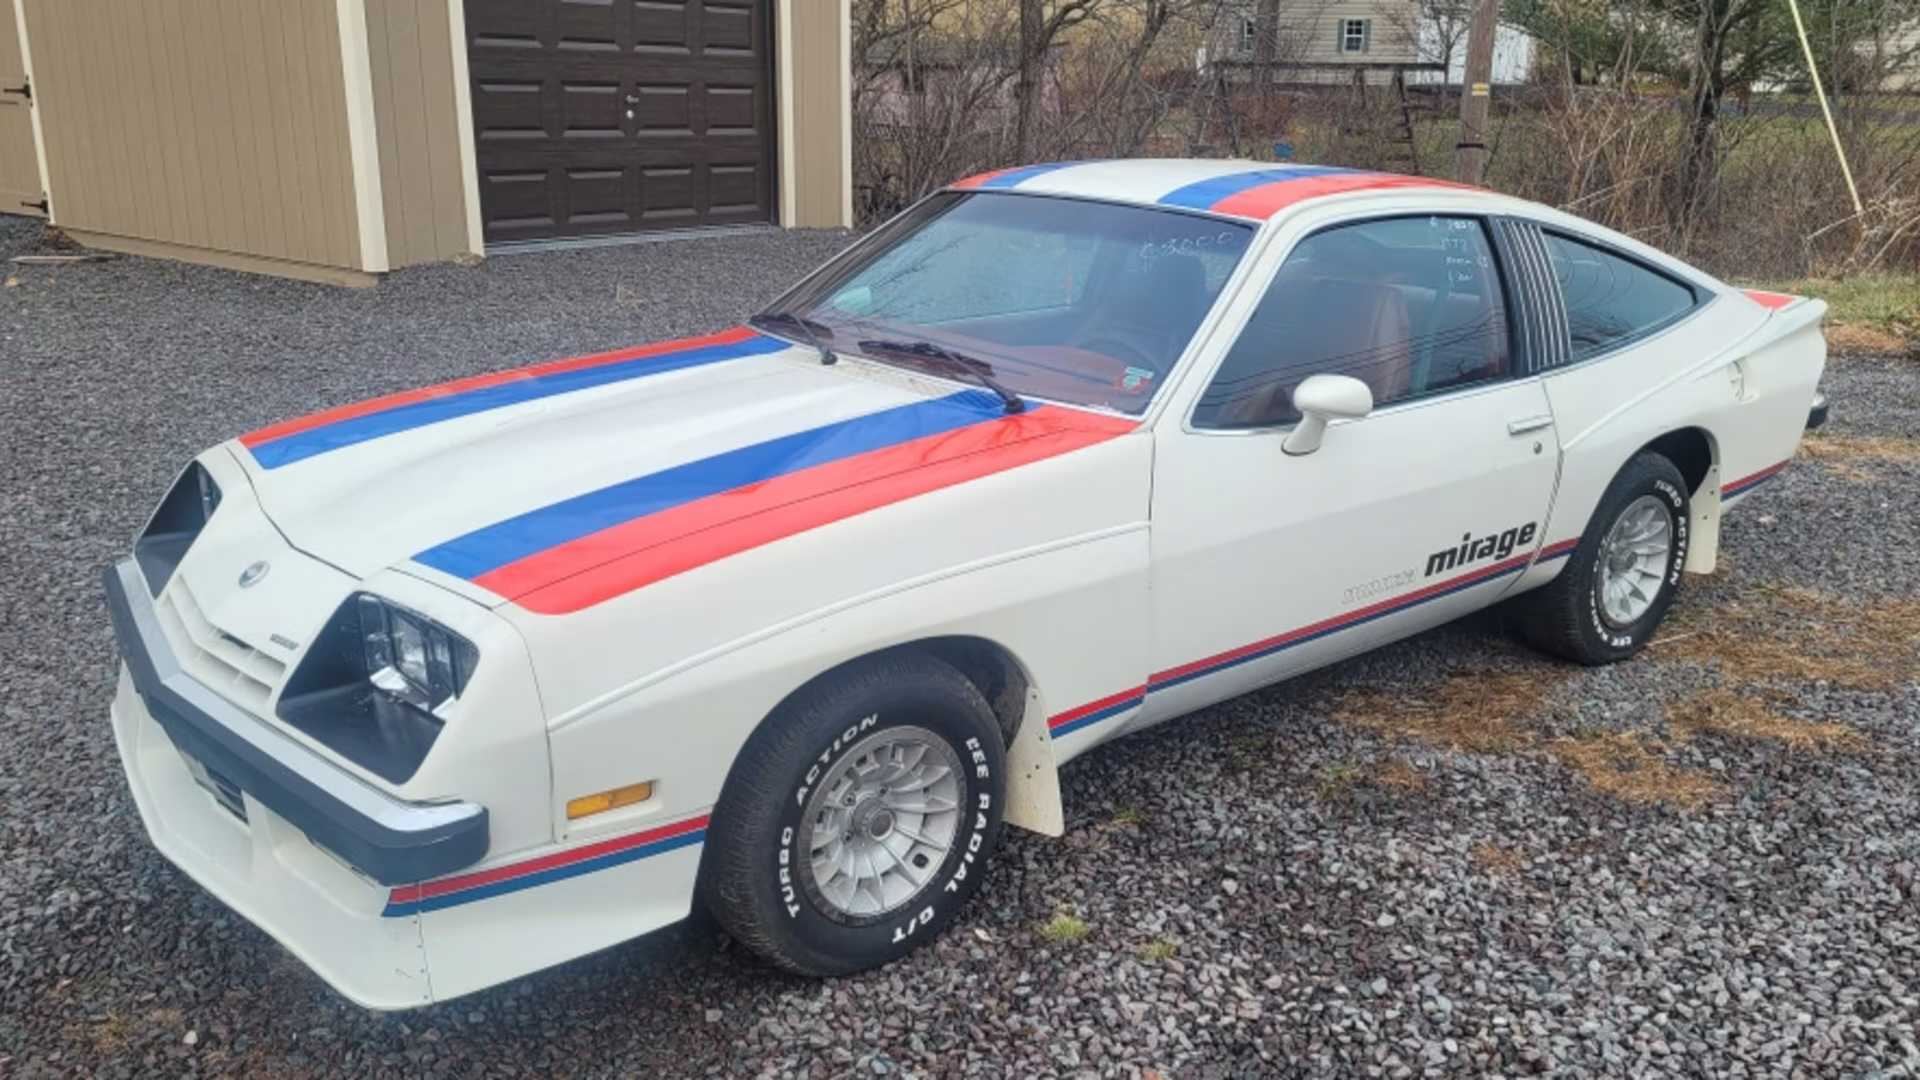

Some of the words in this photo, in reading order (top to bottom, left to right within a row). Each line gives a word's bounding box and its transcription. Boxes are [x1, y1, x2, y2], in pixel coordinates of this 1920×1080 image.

[1424, 520, 1538, 577] mirage
[1655, 479, 1682, 508] TURBO
[1669, 515, 1687, 586] ACTION
[777, 826, 802, 918] TURBO
[796, 712, 879, 806] ACTION
[944, 793, 991, 893] RADIAL
